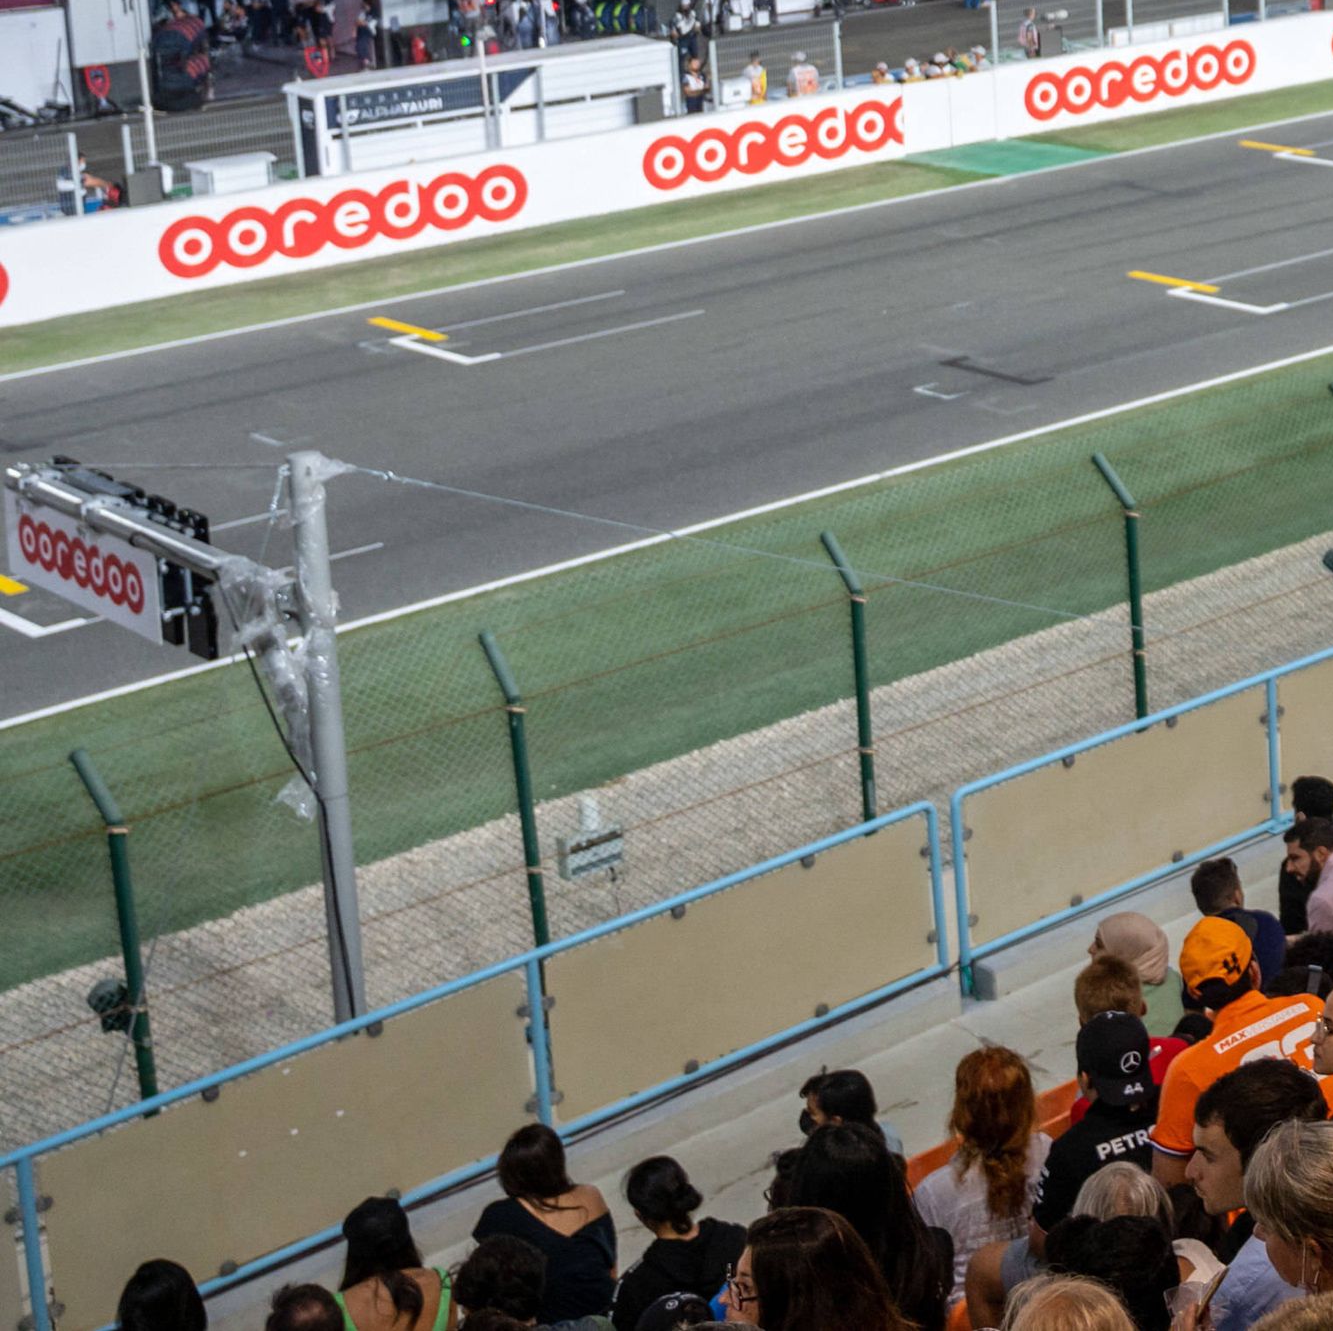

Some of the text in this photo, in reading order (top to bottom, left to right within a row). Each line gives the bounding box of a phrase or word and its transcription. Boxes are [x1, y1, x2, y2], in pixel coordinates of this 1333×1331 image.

[1024, 39, 1257, 122] ooredoo
[158, 164, 529, 280] ooredoo
[18, 513, 145, 615] ooredoo
[1218, 1030, 1248, 1051] MAX
[1123, 1082, 1144, 1096] 44
